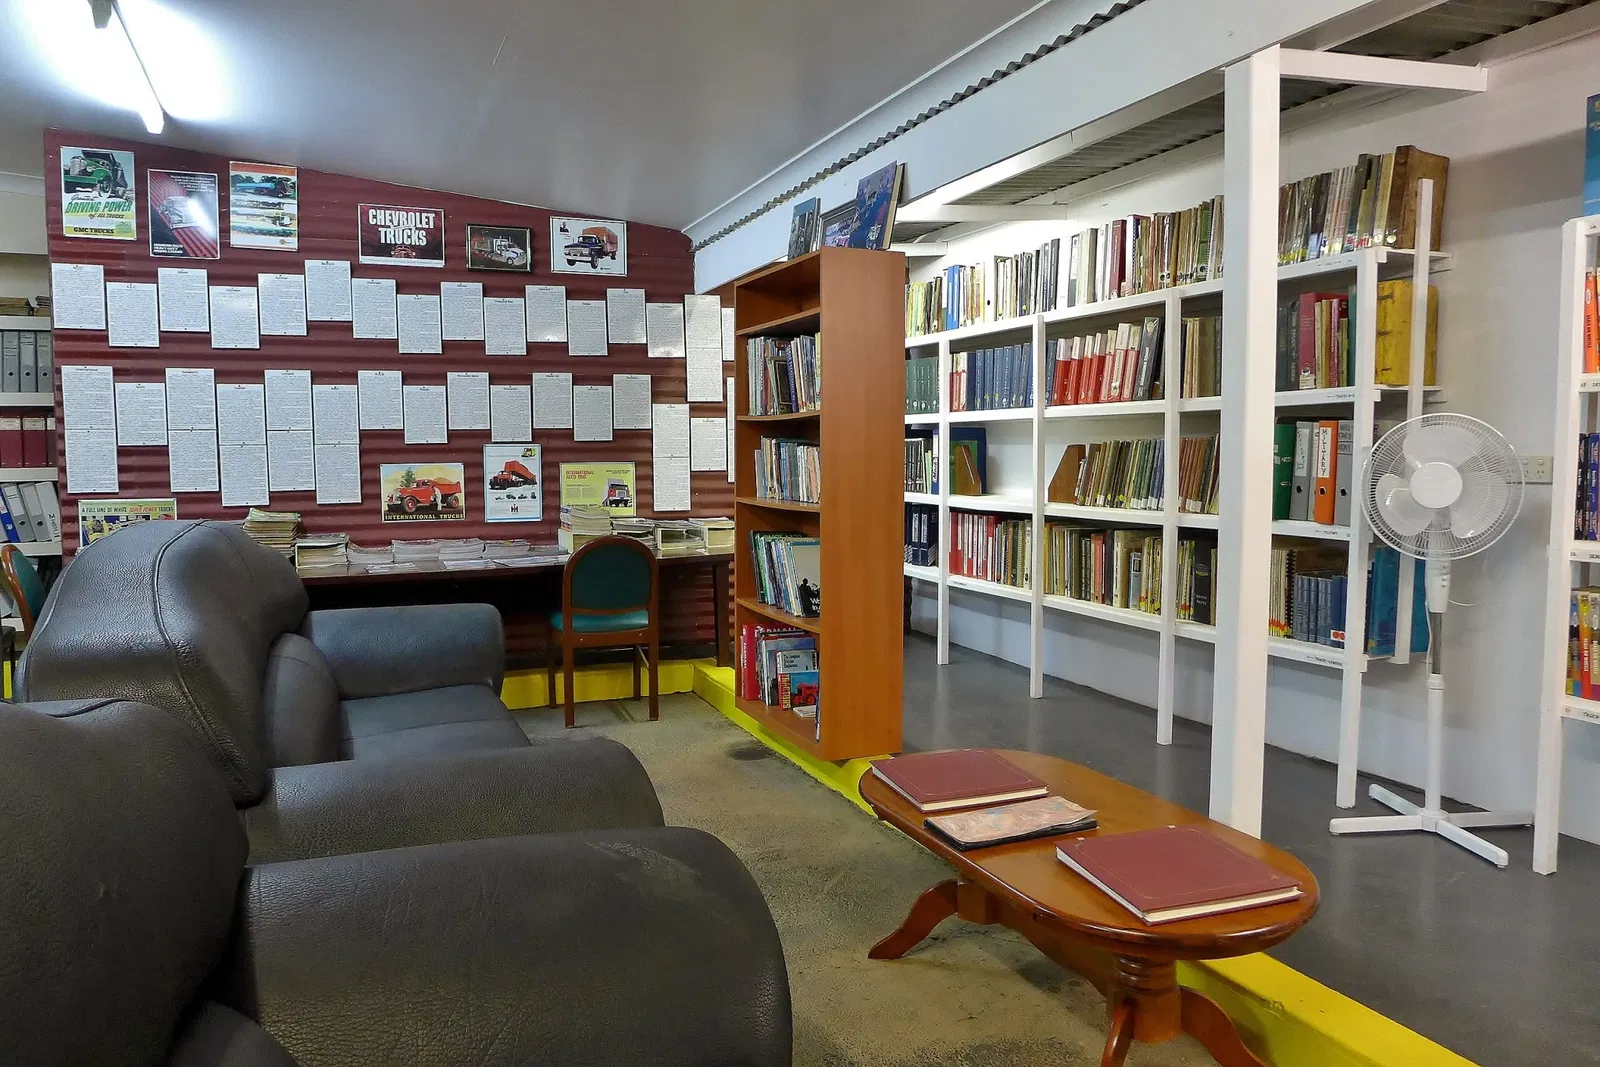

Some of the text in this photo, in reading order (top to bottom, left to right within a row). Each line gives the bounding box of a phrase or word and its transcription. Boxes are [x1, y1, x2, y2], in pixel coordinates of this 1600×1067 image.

[65, 200, 133, 213] DRIVING POWER
[368, 208, 435, 228] CHEVROLET
[378, 228, 426, 246] TRUCKS
[781, 674, 791, 709] TRACTORS
